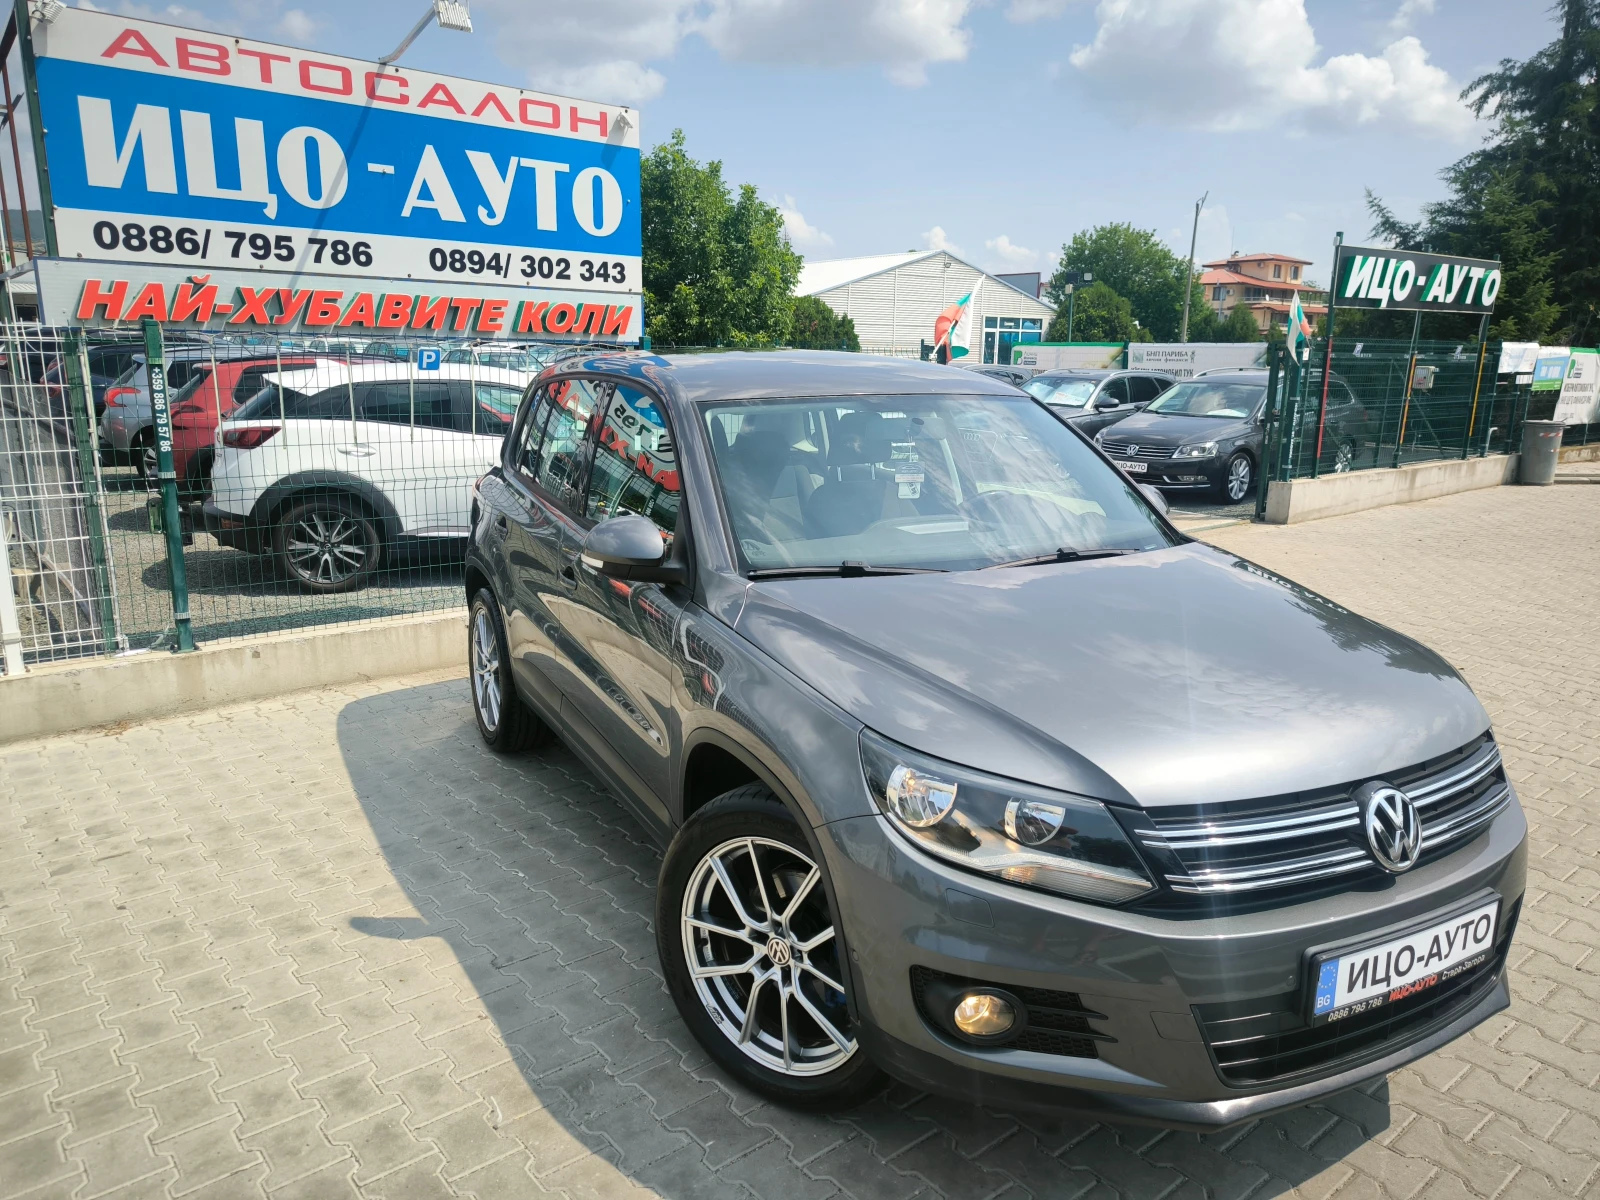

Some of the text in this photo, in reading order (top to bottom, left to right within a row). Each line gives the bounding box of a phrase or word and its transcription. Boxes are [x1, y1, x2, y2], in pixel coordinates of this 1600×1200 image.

[101, 28, 608, 137] АВТОСАЛОН
[93, 221, 373, 267] 0886/ 795 786
[429, 247, 627, 284] 0894/ 302 343
[77, 274, 635, 336] НАЙ-ХУБАВИТЕ КОЛИ
[152, 366, 171, 452] +359 886 79 57 86
[1347, 914, 1491, 994] ИЦО-АУТО
[1442, 966, 1462, 980] Стара
[1317, 995, 1331, 1008] BG
[1328, 997, 1383, 1022] 0886 795 786
